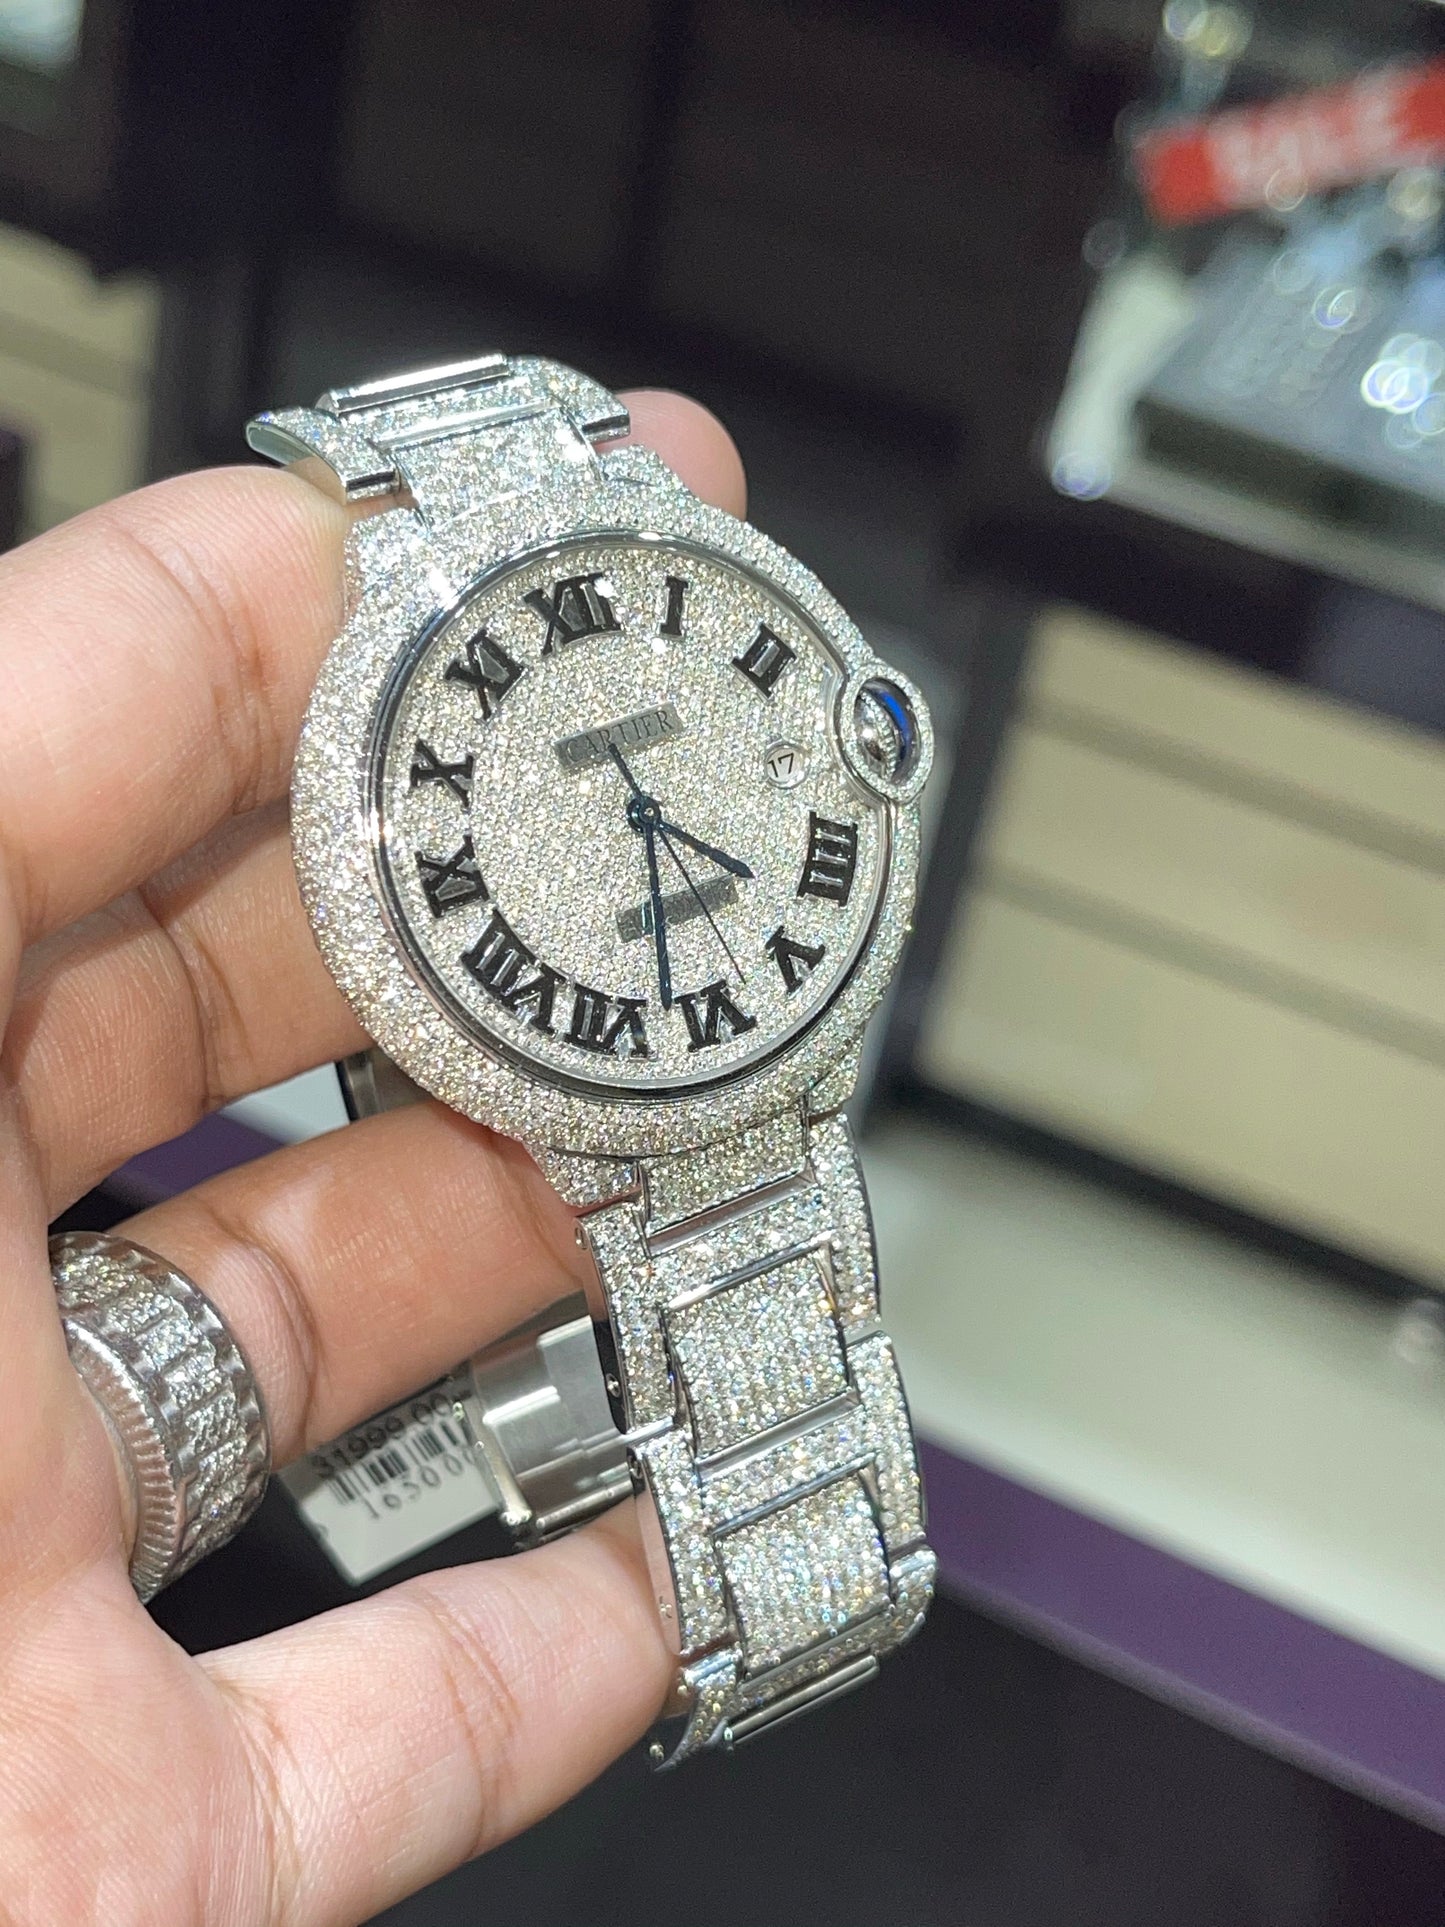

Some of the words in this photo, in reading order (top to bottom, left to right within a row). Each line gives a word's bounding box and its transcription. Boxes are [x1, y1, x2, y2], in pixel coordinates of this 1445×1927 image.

[522, 572, 622, 655] XII
[660, 575, 689, 636] I
[445, 628, 525, 721] XI
[731, 623, 797, 699] II
[565, 709, 674, 763] CARTIER
[767, 752, 795, 778] 17
[410, 739, 474, 811] X
[414, 834, 490, 919] IX
[460, 907, 567, 1034] VIII
[765, 925, 826, 995] V
[564, 981, 648, 1060] VII
[673, 979, 758, 1053] VI
